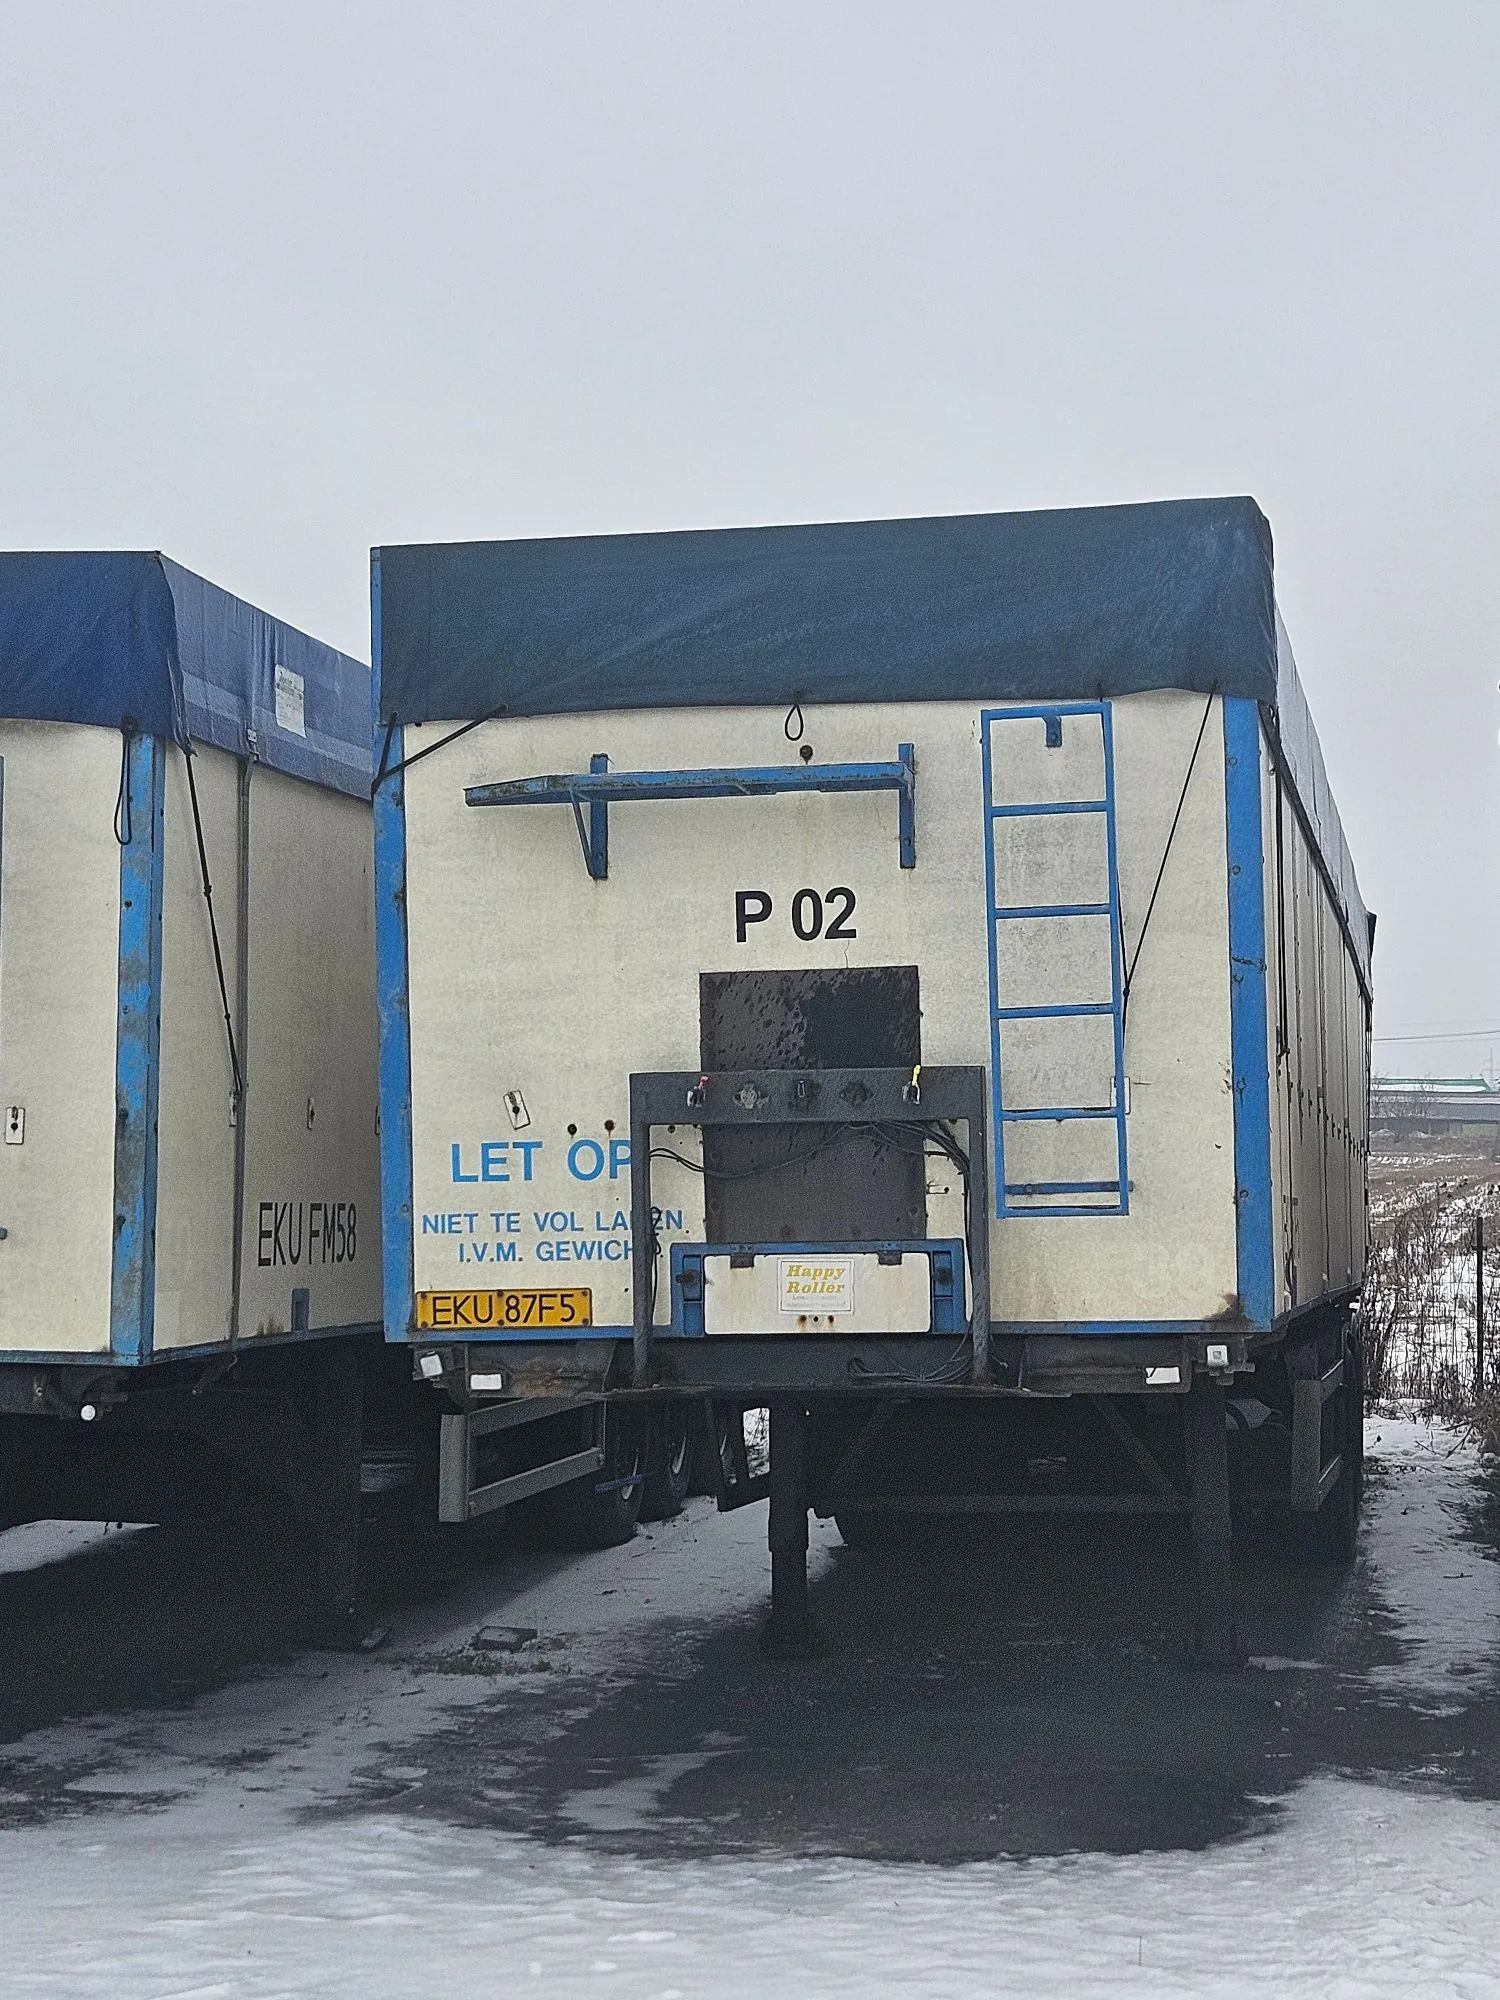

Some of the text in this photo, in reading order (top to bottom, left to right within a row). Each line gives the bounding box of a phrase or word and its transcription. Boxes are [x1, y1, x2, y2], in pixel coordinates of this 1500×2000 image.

[735, 886, 857, 943] P 02
[451, 1138, 633, 1183] LET OP
[257, 1202, 357, 1267] EKU FM58
[422, 1209, 683, 1235] NIET TE VOL LAEN
[458, 1242, 524, 1263] I.V.M.
[786, 1264, 846, 1281] Happy
[786, 1281, 846, 1294] Roller
[431, 1293, 576, 1326] EKU 87F5
